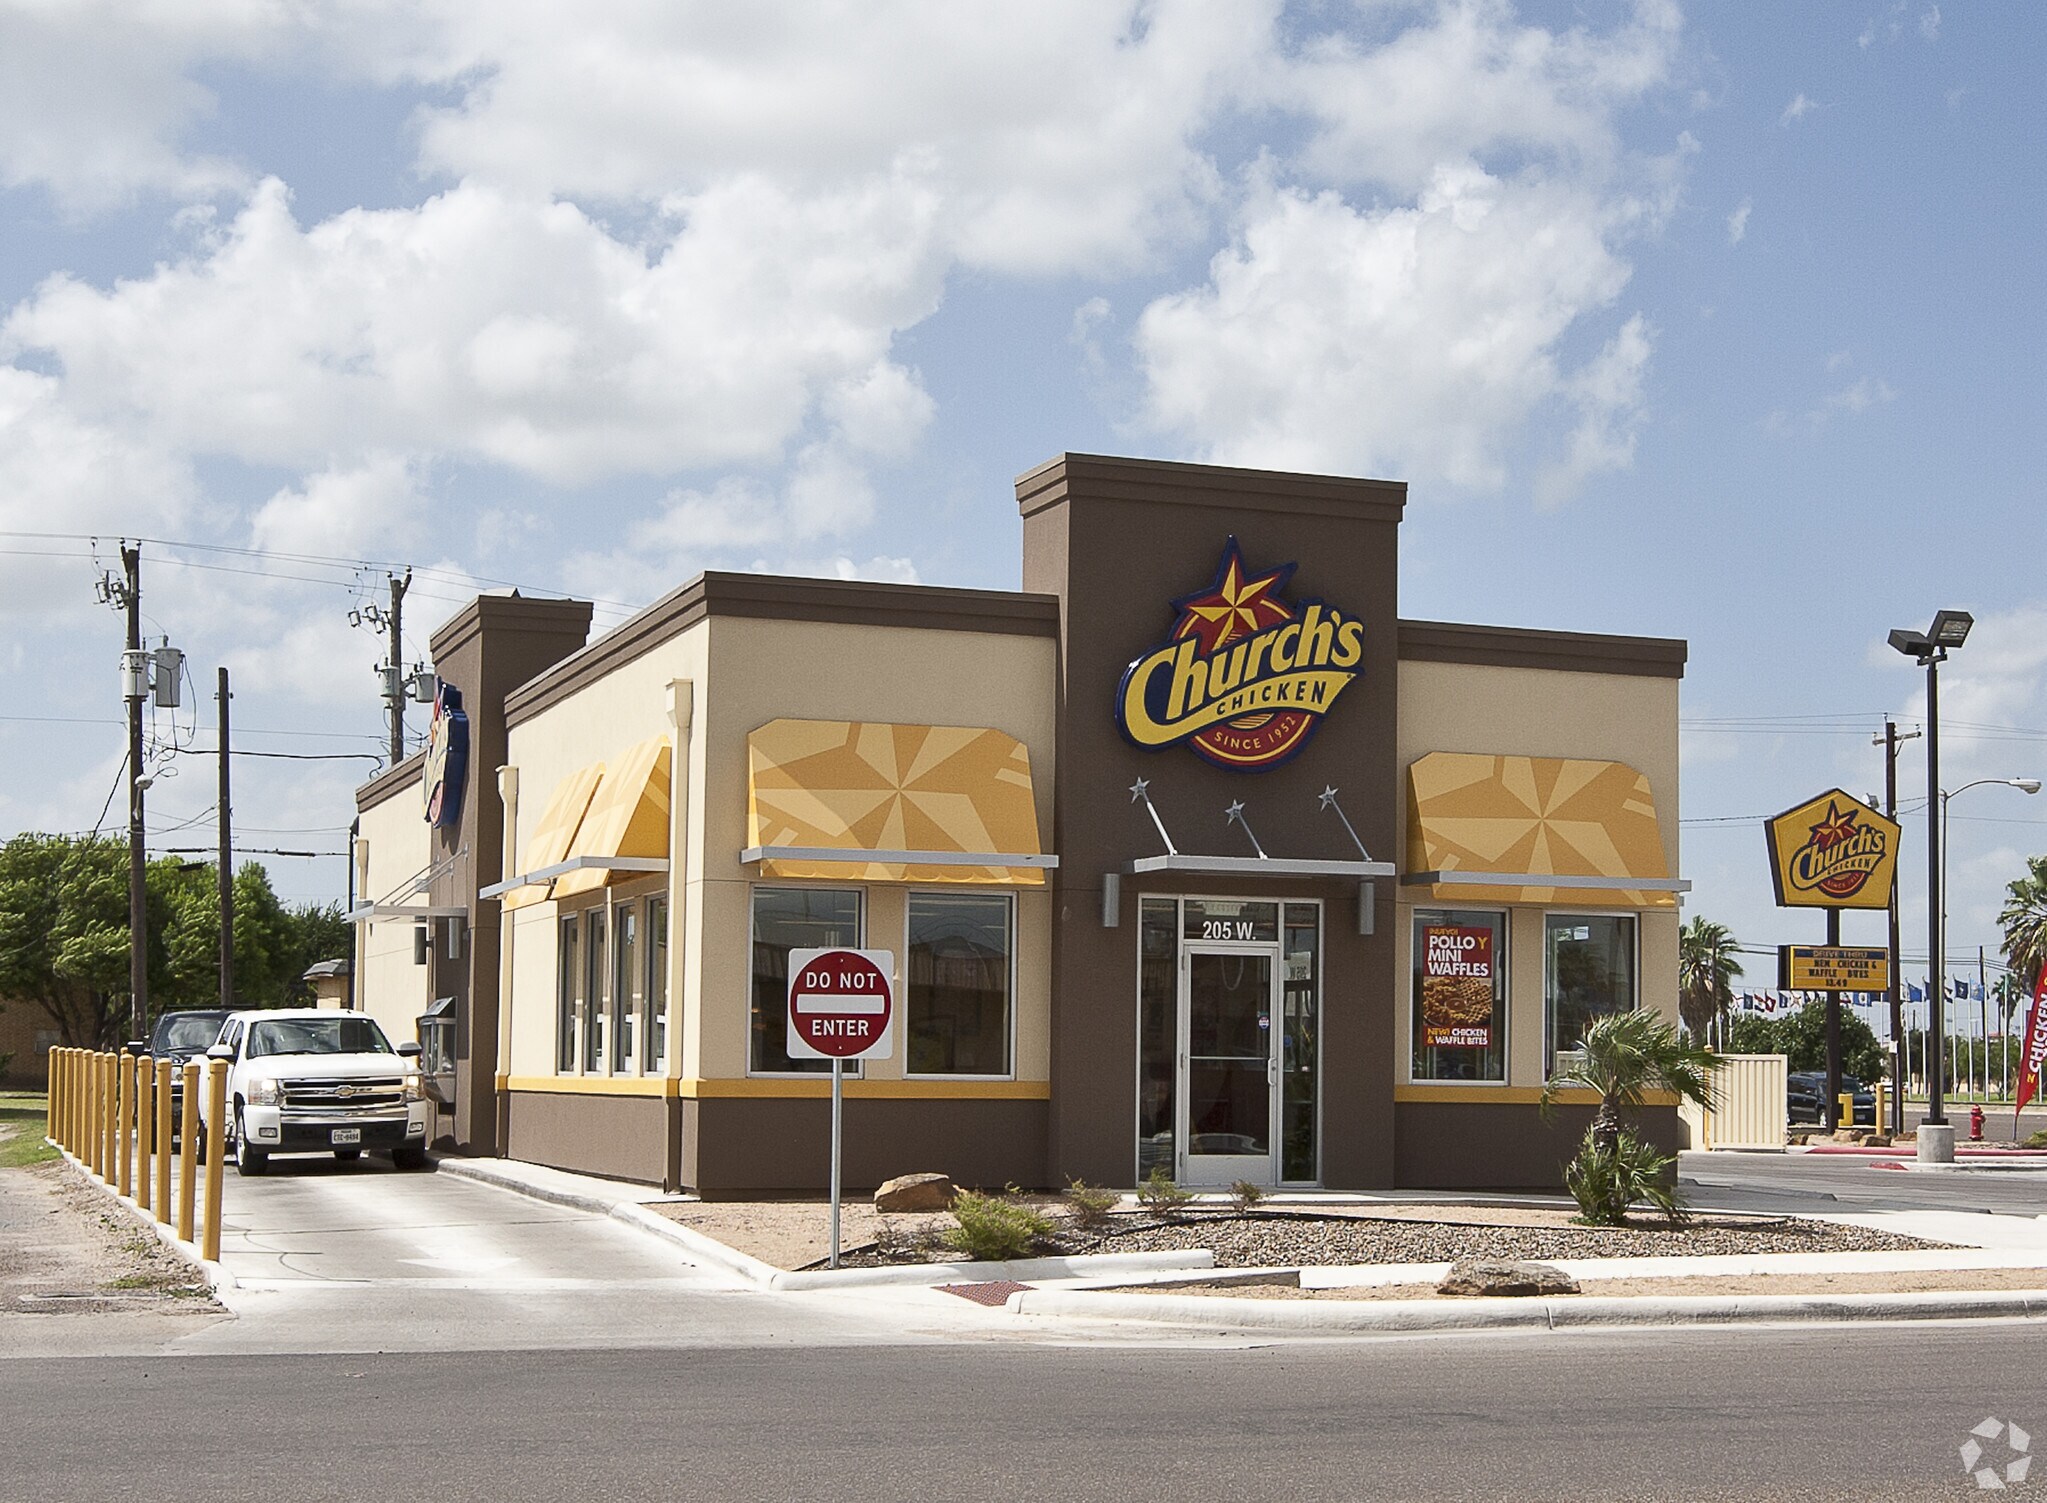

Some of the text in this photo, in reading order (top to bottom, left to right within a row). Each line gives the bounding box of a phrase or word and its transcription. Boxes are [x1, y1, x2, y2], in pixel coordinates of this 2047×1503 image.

[1125, 605, 1363, 745] Church's
[1216, 681, 1327, 715] CHICKEN
[1214, 716, 1296, 749] SINCE 1952
[1792, 826, 1884, 888] Church's
[1202, 920, 1257, 940] 205 W.
[1429, 935, 1488, 950] POLLO Y
[1428, 949, 1462, 962] MINI
[1428, 962, 1489, 976] WAFFLES
[806, 972, 877, 989] DO NOT
[812, 1019, 869, 1036] ENTER
[1451, 1028, 1488, 1037] CHICKEN
[2028, 993, 2047, 1073] CHICKEN
